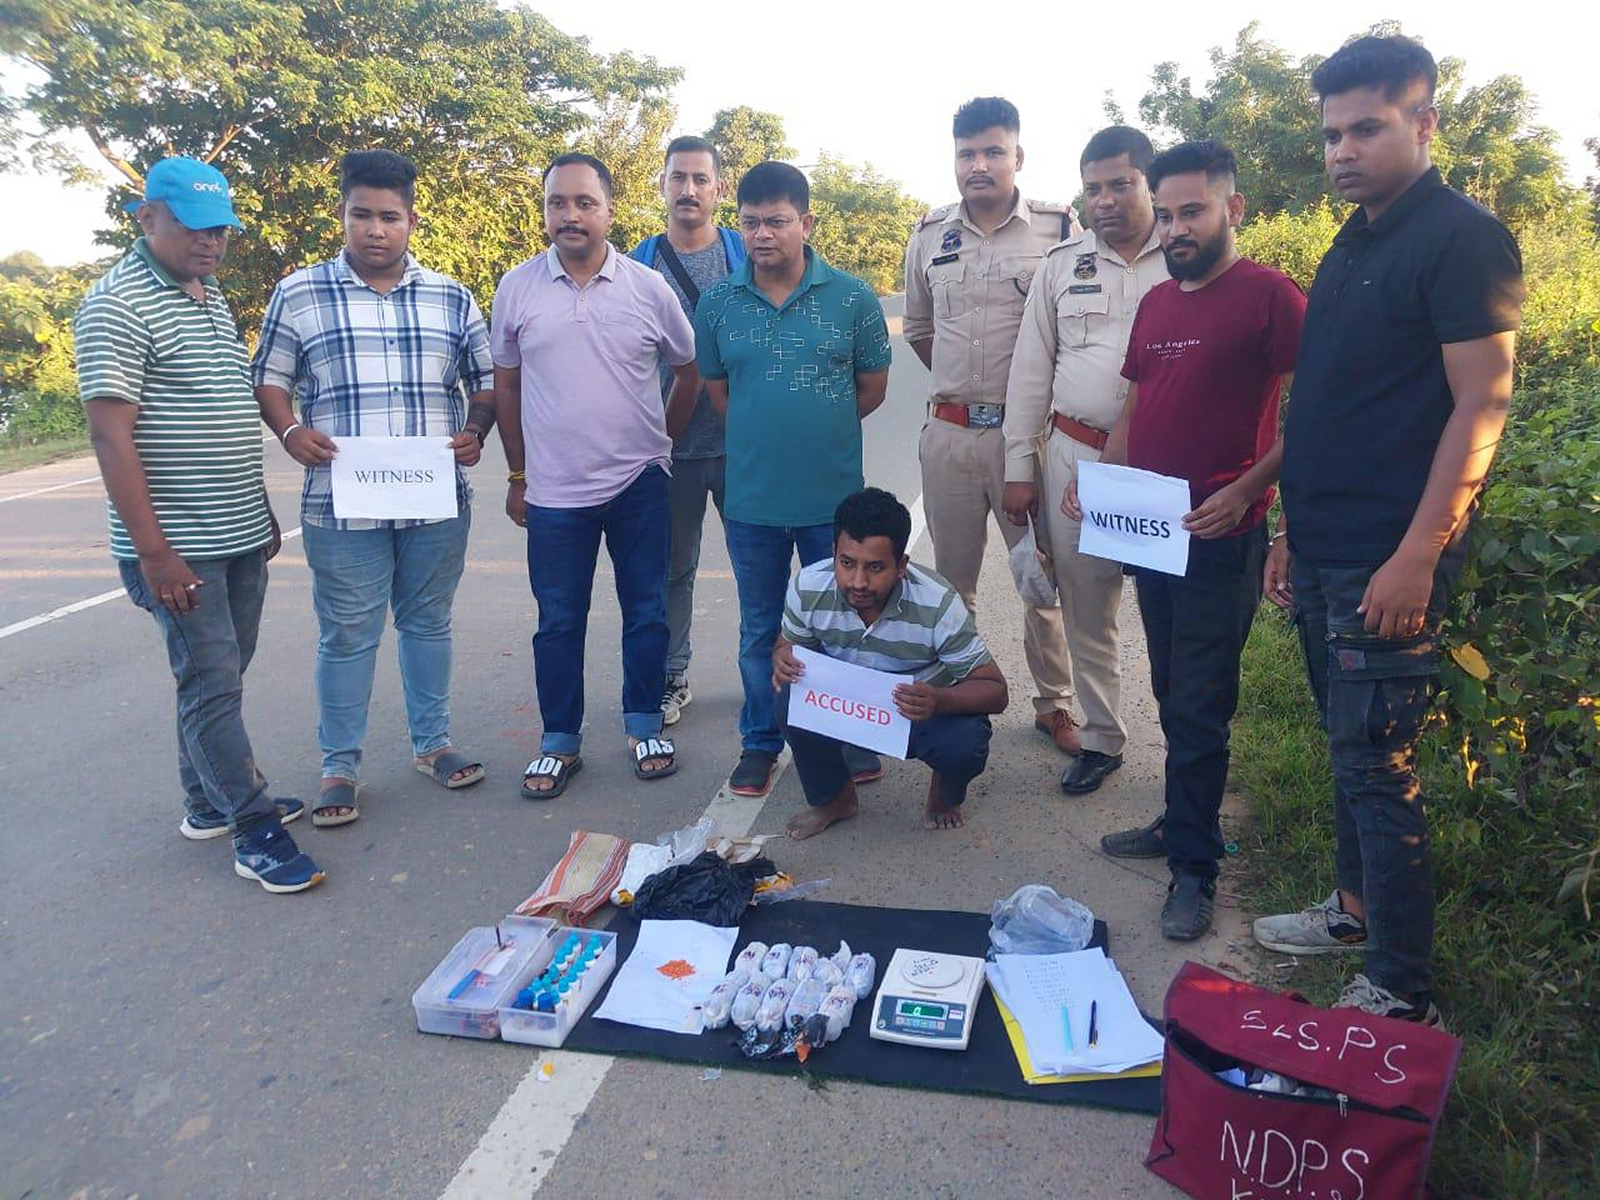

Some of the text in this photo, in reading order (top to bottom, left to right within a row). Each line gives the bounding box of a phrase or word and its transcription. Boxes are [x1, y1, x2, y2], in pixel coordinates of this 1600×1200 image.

[355, 469, 434, 483] WITNESS
[1089, 510, 1170, 539] WITNESS
[805, 689, 891, 726] ACCUSED
[636, 738, 674, 761] DAS
[524, 757, 563, 776] ADI
